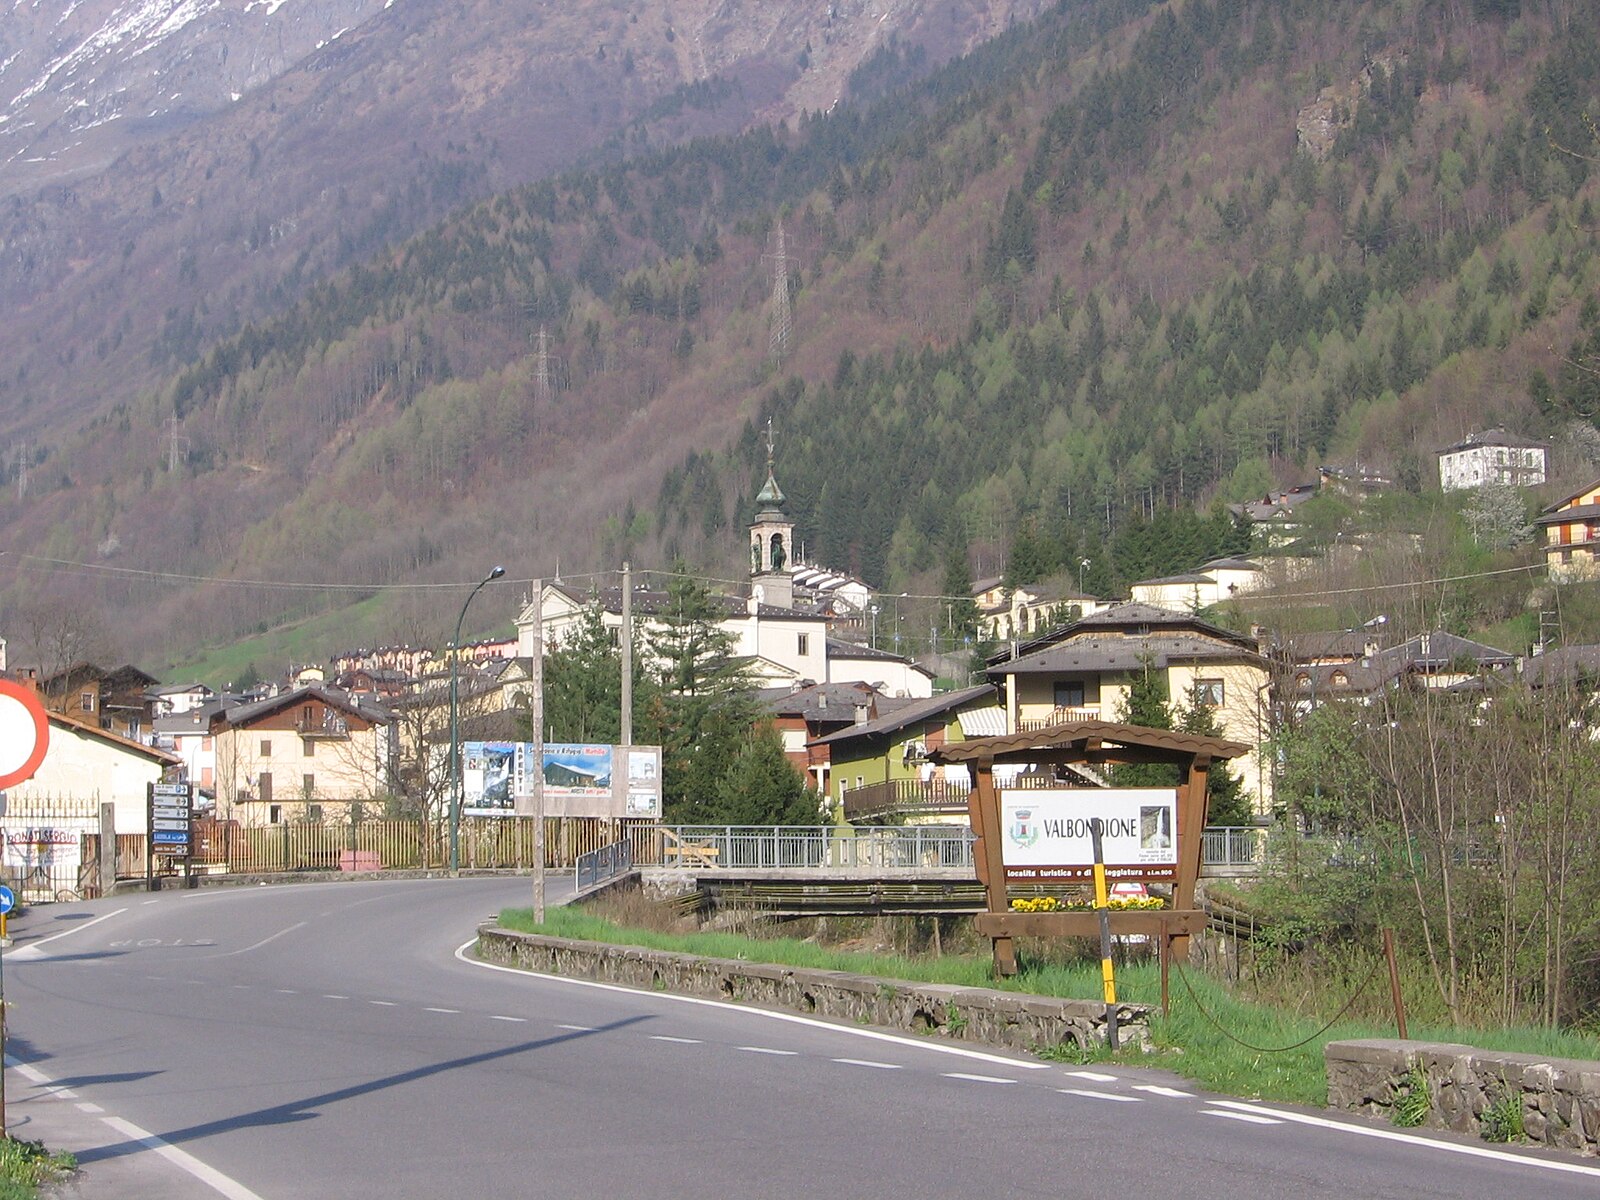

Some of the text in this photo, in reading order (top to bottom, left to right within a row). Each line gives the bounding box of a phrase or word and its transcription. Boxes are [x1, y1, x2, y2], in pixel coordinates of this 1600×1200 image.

[1044, 818, 1136, 838] VALBONDIONE
[1039, 869, 1072, 877] turistica
[1083, 869, 1092, 877] di
[1104, 868, 1143, 878] leggiatura
